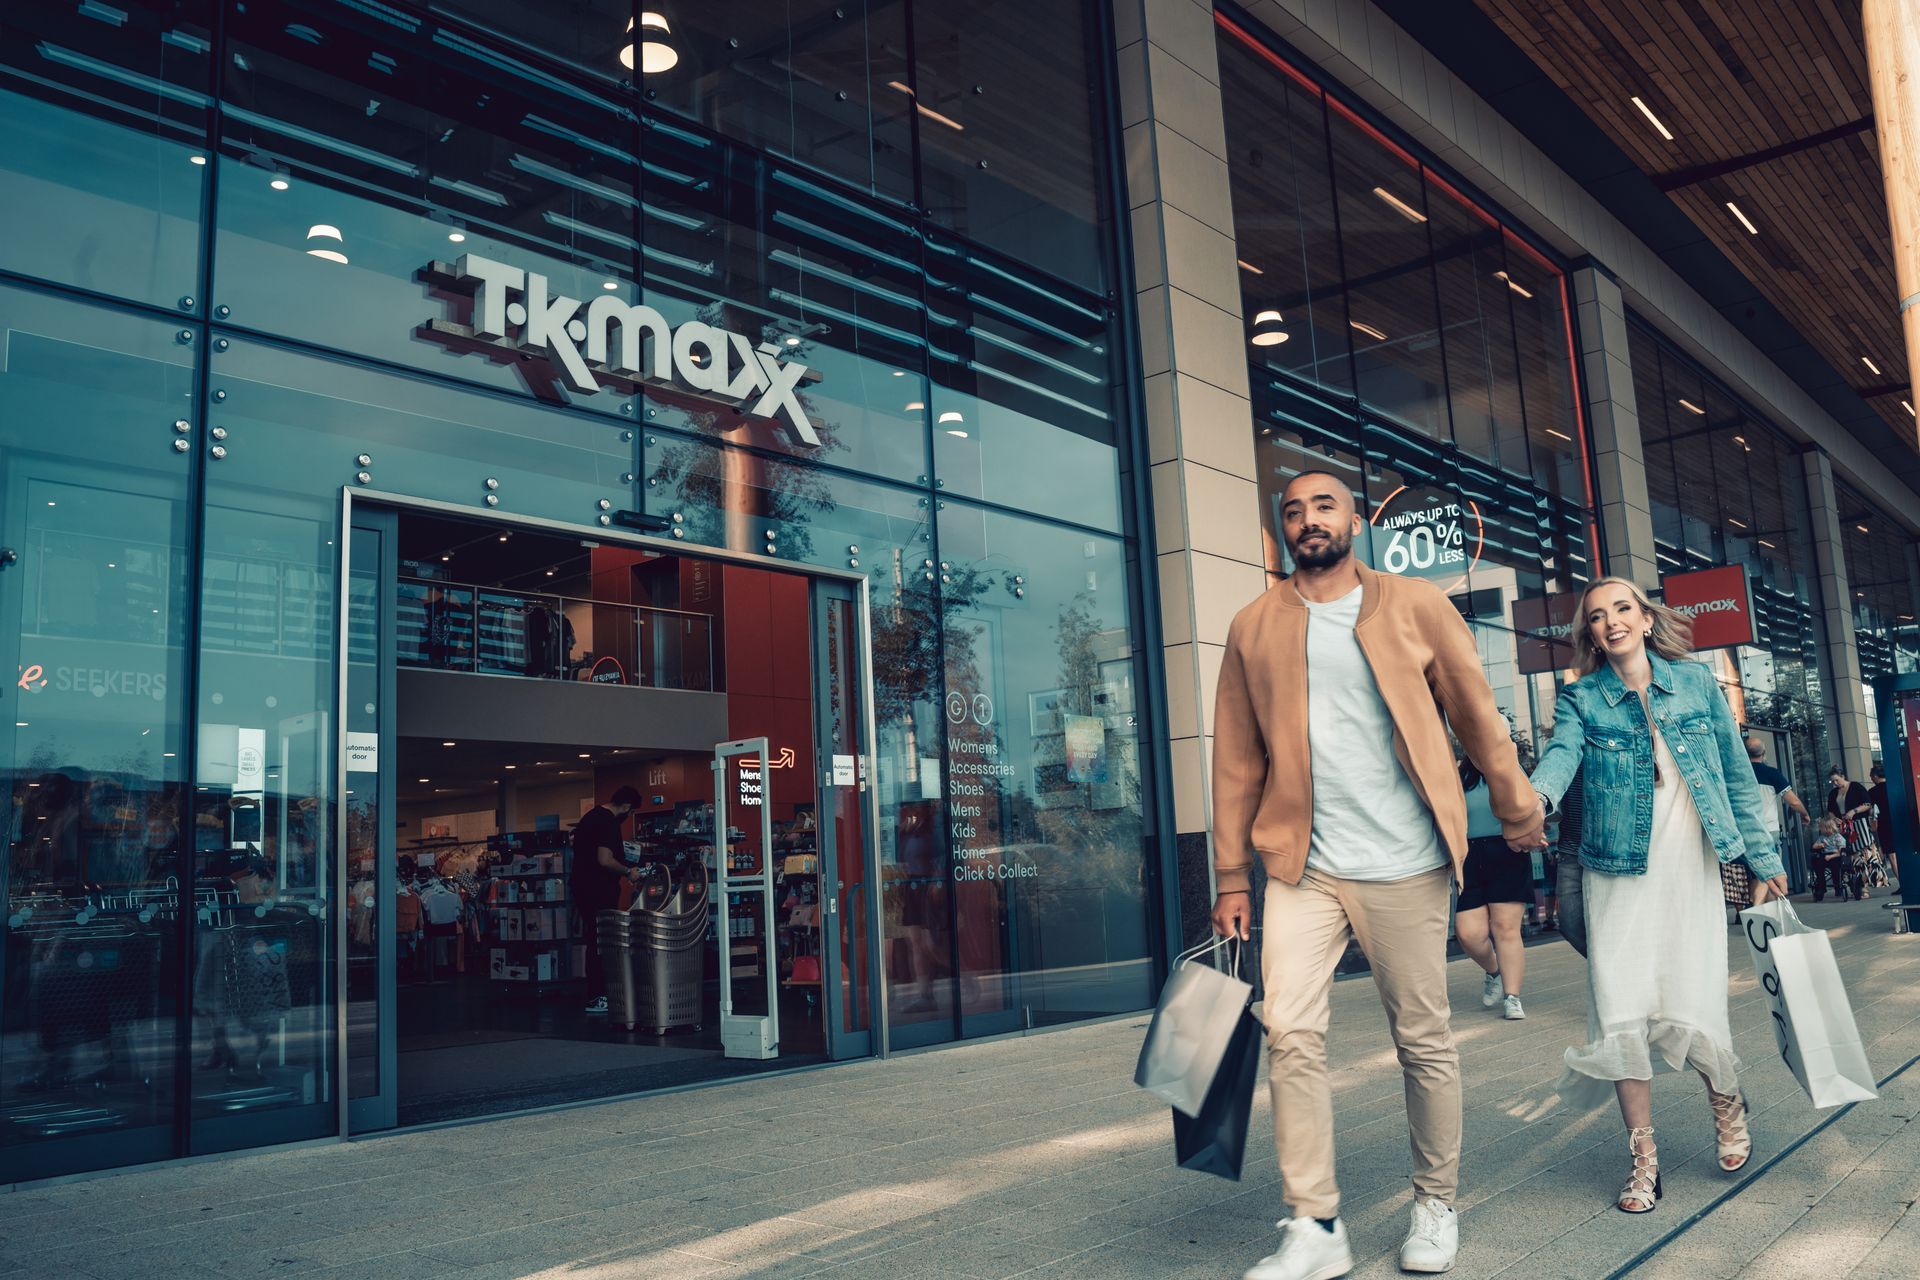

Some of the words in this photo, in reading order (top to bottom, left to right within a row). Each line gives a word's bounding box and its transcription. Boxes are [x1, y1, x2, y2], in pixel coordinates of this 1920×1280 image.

[1383, 511, 1425, 531] ALWAYS
[1427, 507, 1442, 521] UP
[1445, 504, 1460, 518] TO
[1384, 520, 1463, 574] 60%
[1439, 549, 1464, 565] LESS
[55, 666, 167, 696] SEEKERS
[948, 737, 998, 755] Womens
[740, 769, 762, 780] Mens
[949, 761, 1015, 776] Accessories
[649, 769, 667, 786] Lift
[740, 782, 762, 793] Shoe
[950, 780, 984, 796] Shoes
[950, 802, 981, 817] Mens
[952, 823, 976, 838] Kids
[953, 845, 986, 860] Home
[954, 865, 984, 882] Click
[987, 863, 995, 880] &
[998, 863, 1038, 880] Collect
